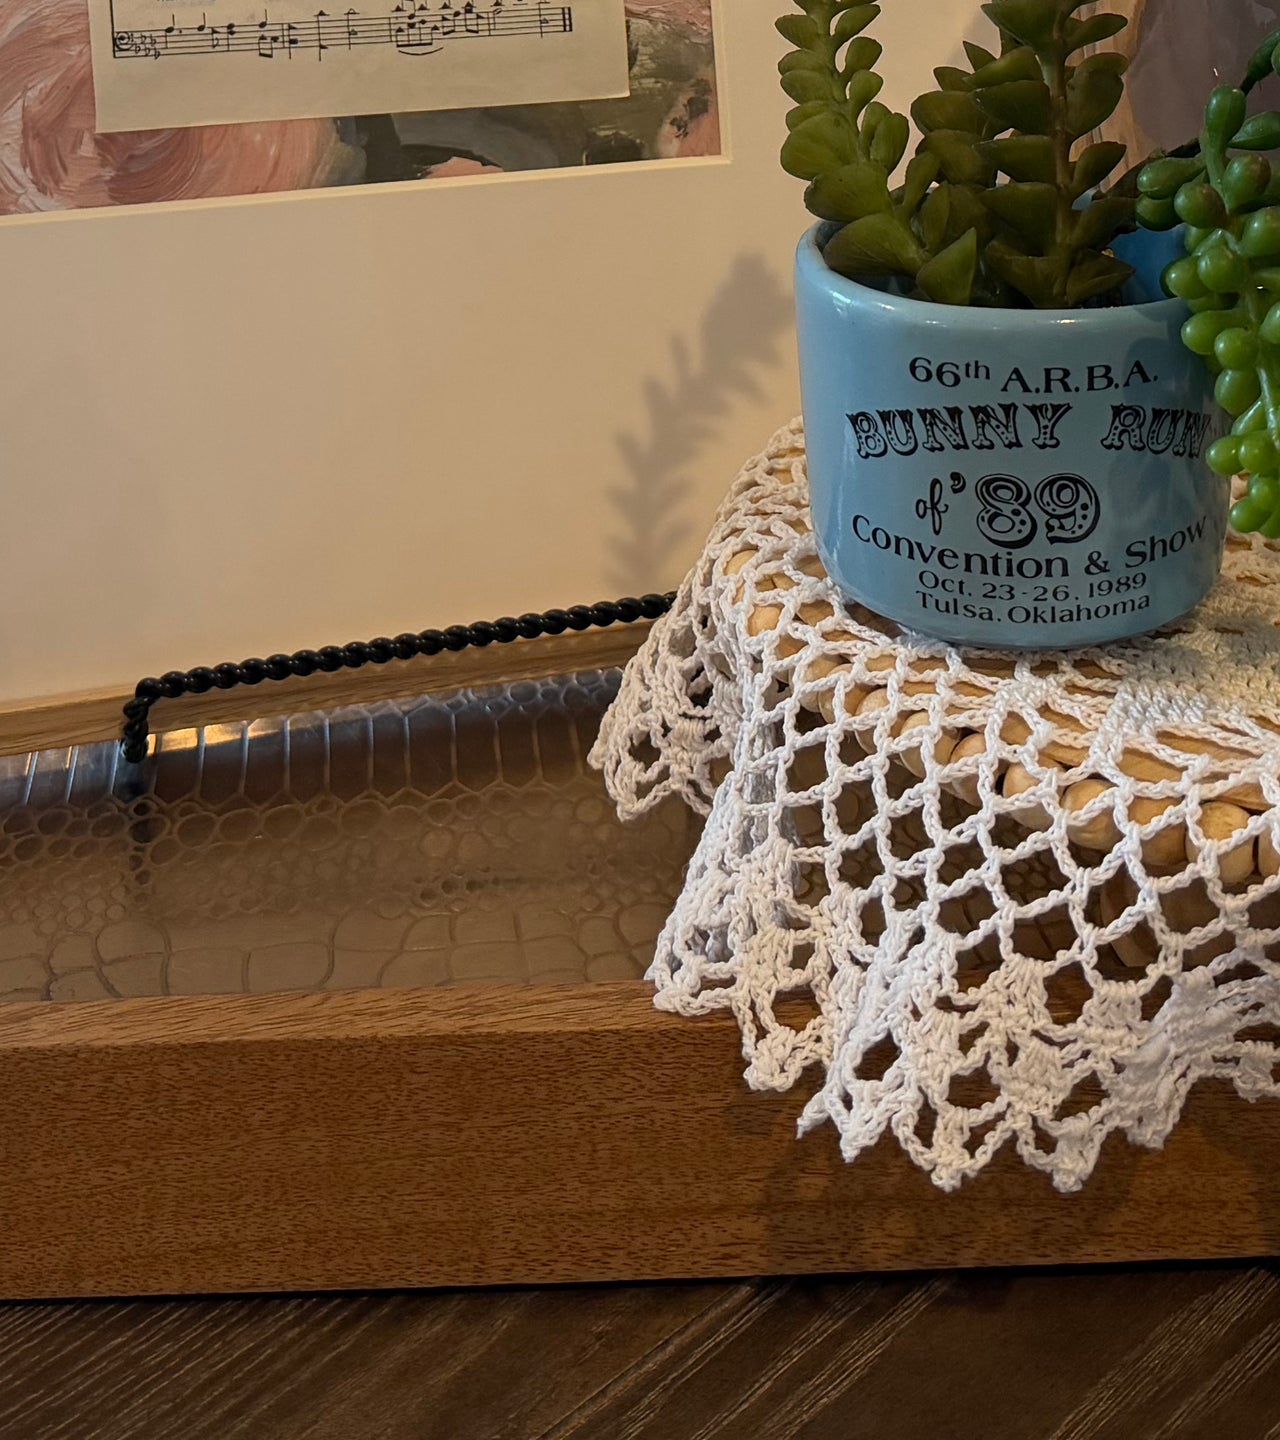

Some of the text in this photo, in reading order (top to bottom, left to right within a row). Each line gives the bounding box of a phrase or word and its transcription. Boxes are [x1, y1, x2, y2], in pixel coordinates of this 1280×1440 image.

[909, 357, 991, 388] 66th
[845, 402, 1212, 459] BUNNY RUN
[915, 477, 949, 536] of
[852, 514, 1207, 579] Convention & Show
[919, 570, 972, 597] Oct.
[1088, 572, 1147, 598] 1989
[1008, 595, 1150, 624] Oklahoma
